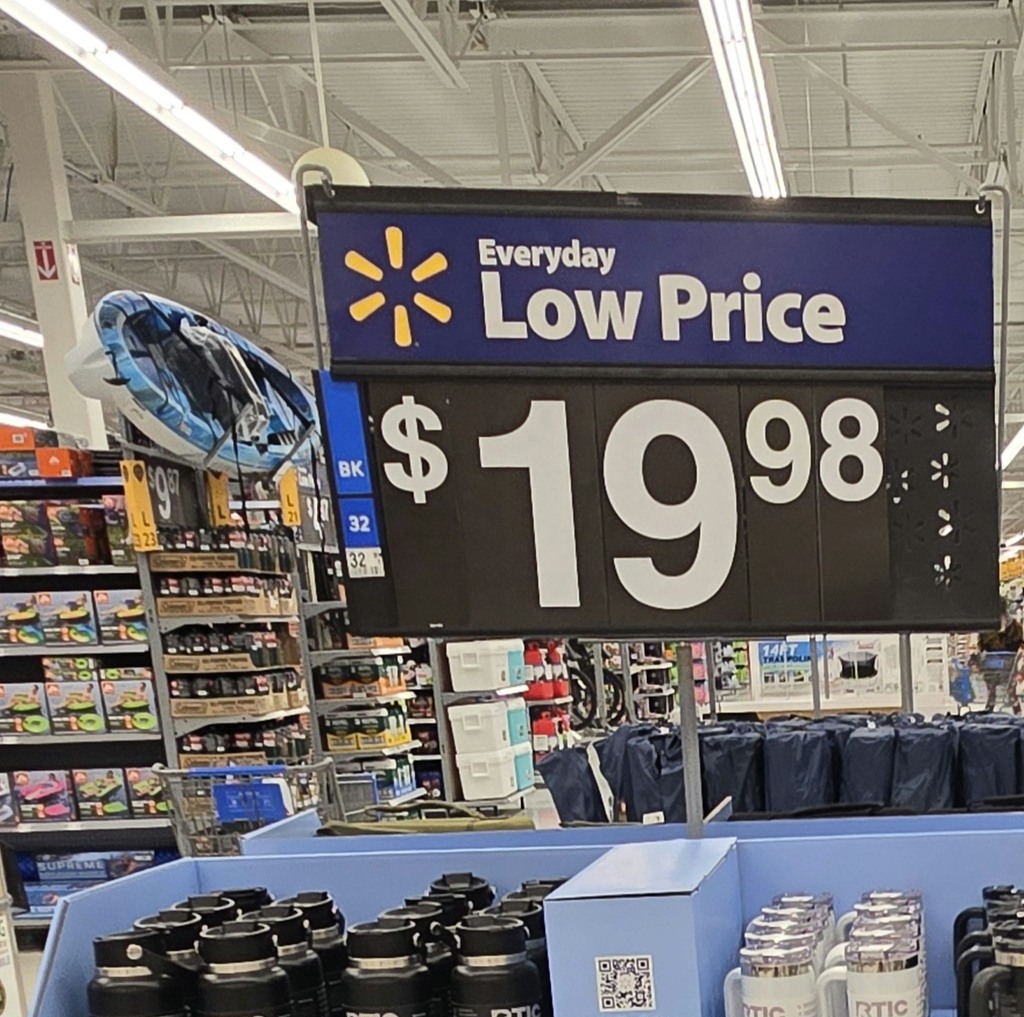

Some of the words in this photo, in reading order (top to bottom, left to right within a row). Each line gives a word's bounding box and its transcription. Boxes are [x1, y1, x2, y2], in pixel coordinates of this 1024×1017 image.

[479, 238, 615, 274] Everyday
[481, 271, 643, 341] Low
[658, 272, 846, 344] Price
[338, 460, 365, 477] BK
[287, 494, 294, 507] L
[381, 396, 449, 504] $
[478, 399, 738, 609] 19
[745, 397, 883, 504] 98
[142, 511, 150, 527] L
[348, 515, 371, 532] 32
[142, 532, 156, 547] 23
[349, 552, 366, 568] 32
[39, 860, 105, 872] SUPREME
